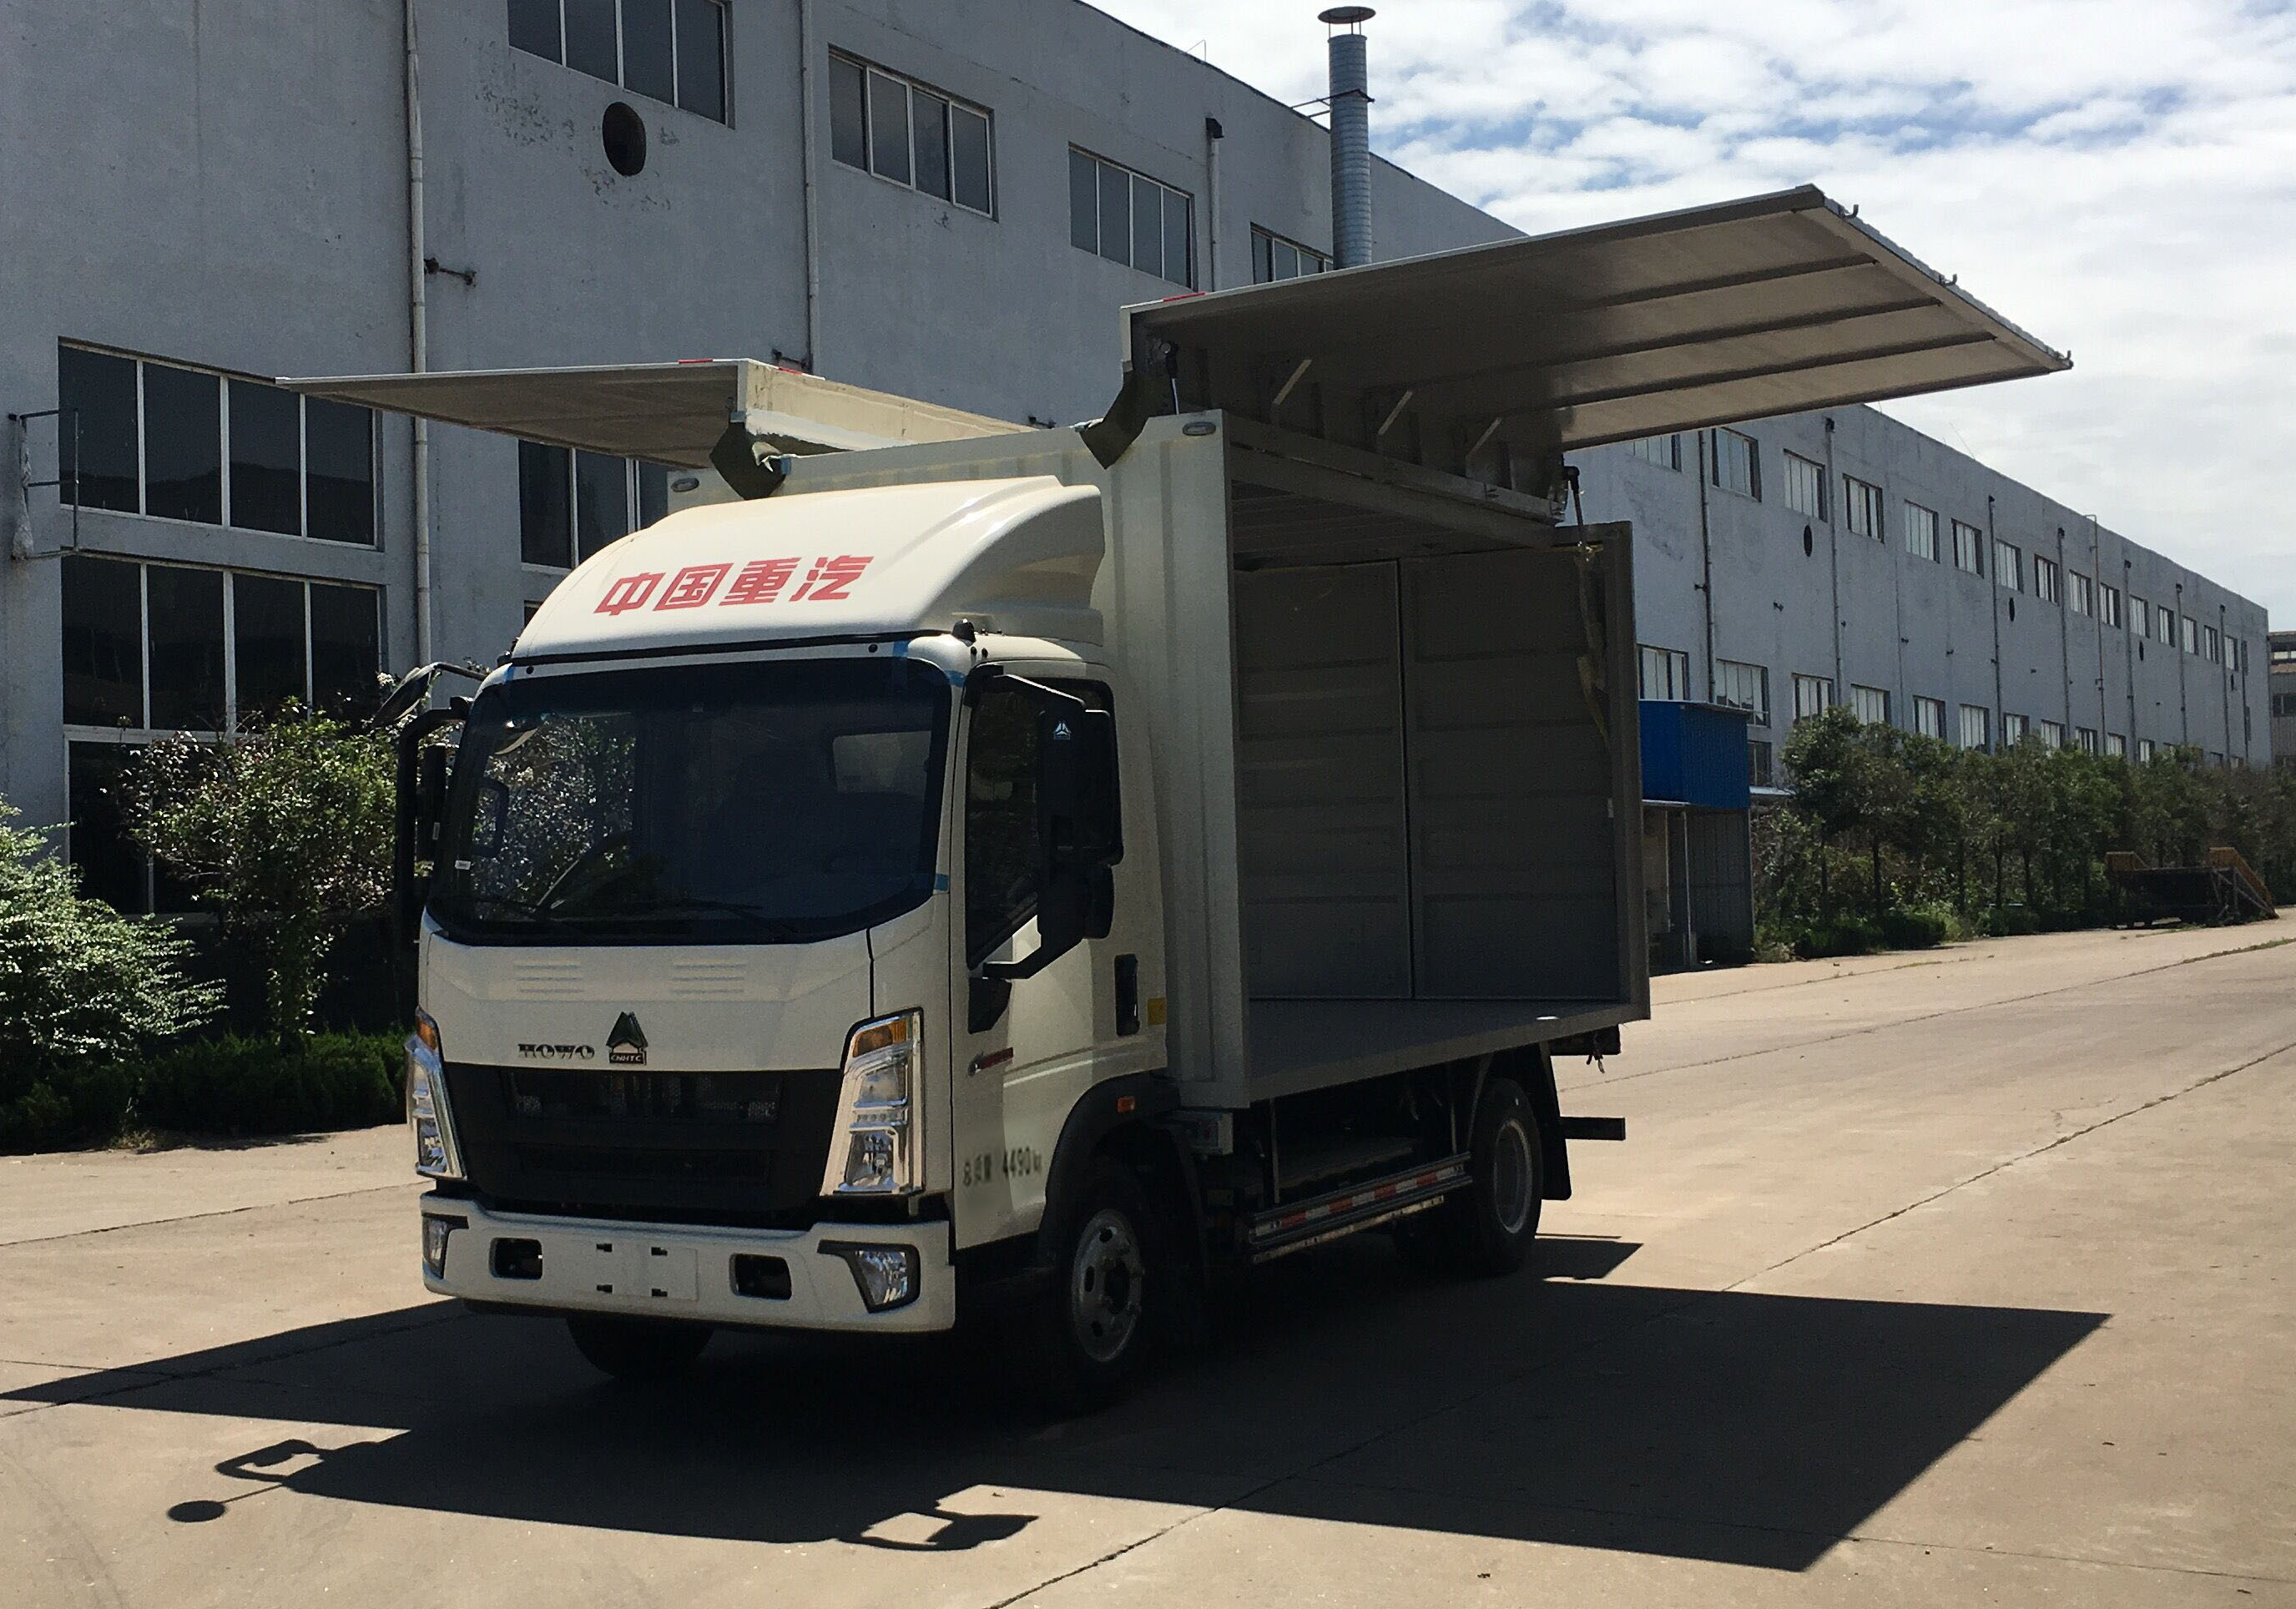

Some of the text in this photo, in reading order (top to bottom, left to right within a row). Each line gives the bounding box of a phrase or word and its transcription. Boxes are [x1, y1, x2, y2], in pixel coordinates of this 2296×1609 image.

[593, 555, 874, 615] 中国重汽
[517, 1043, 595, 1060] HOWO
